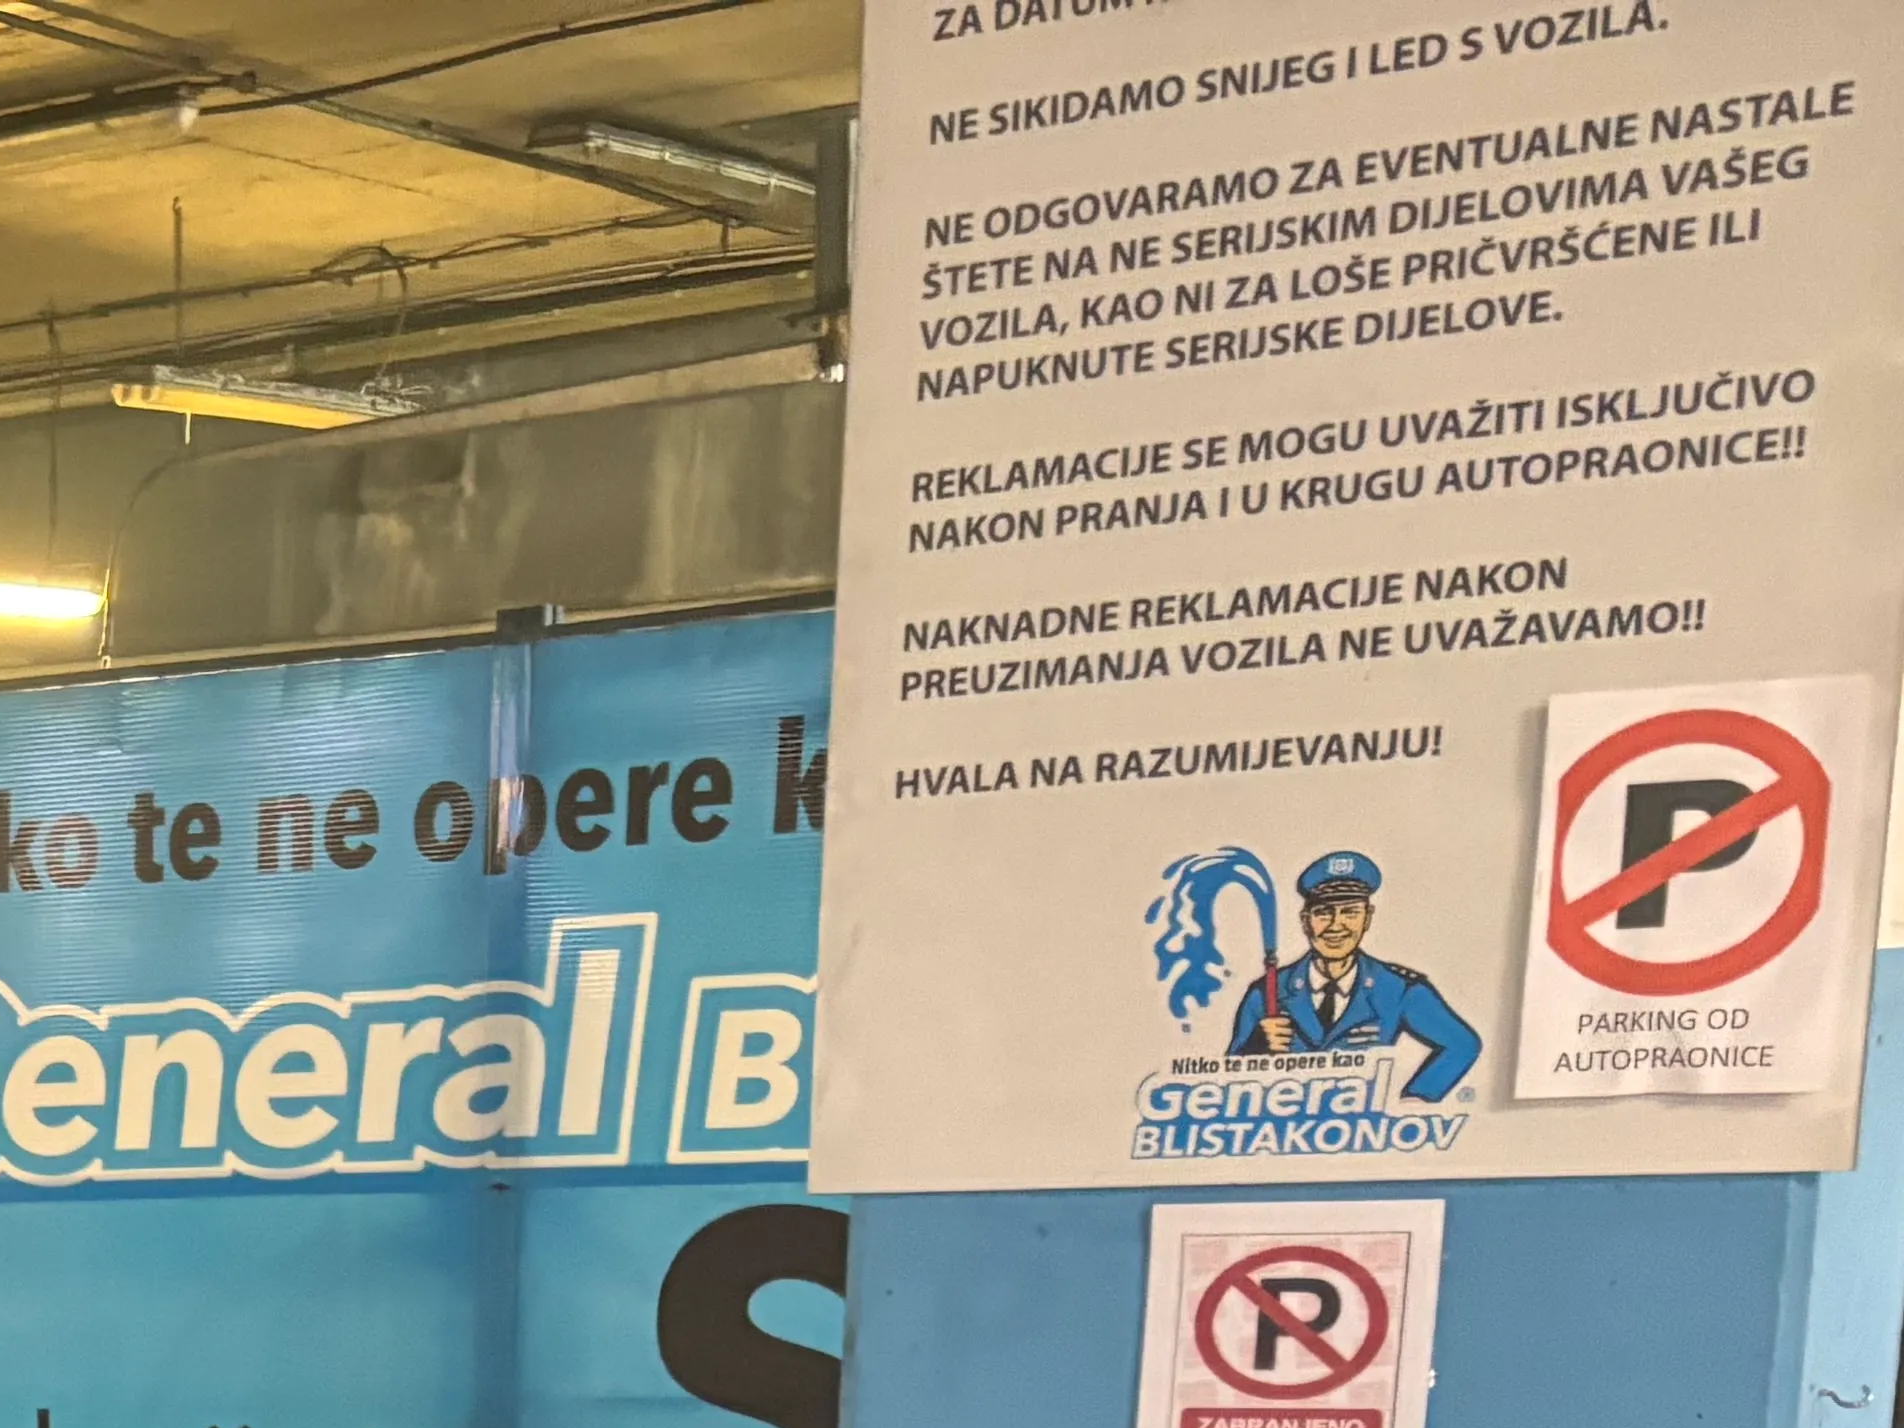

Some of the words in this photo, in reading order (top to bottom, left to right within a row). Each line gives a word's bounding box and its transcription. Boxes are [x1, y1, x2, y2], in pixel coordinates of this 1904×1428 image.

[929, 107, 979, 146] NE
[988, 75, 1185, 136] SIKIDAMO
[1196, 50, 1335, 103] SNIJEG
[1346, 46, 1357, 80] I
[1368, 33, 1448, 76] LED
[1459, 26, 1484, 62] S
[1494, 0, 1669, 55] VOZILA.
[933, 5, 984, 41] ZA
[924, 212, 974, 249] NE
[983, 166, 1280, 239] ODGOVARAMO
[1288, 157, 1343, 195] ZA
[1355, 112, 1638, 186] EVENTUALNE
[1650, 80, 1856, 144] NASTALE
[921, 254, 1033, 300] ŠTETE
[1043, 245, 1099, 283] NA
[1110, 235, 1161, 273] NE
[1171, 205, 1376, 265] SERIJSKIM
[1388, 168, 1649, 235] DIJELOVIMA
[1661, 144, 1809, 196] VAŠEG
[919, 303, 1069, 351] VOZILA,
[1080, 288, 1164, 329] KAO
[1174, 280, 1214, 316] NI
[1224, 272, 1279, 310] ZA
[1290, 254, 1391, 301] LOŠE
[1402, 216, 1697, 287] PRIČVRŠĆENE
[1708, 207, 1761, 247] ILI
[916, 340, 1155, 402] NAPUKNUTE
[1165, 316, 1344, 369] SERIJSKE
[1354, 290, 1563, 346] DIJELOVE.
[911, 441, 1172, 503] REKLAMACIJE
[1181, 435, 1228, 471] SE
[1238, 418, 1368, 464] MOGU
[1379, 398, 1545, 448] UVAŽITI
[1556, 368, 1816, 429] ISKLJUČIVO
[908, 508, 1044, 554] NAKON
[1055, 489, 1208, 536] PRANJA
[1219, 486, 1230, 518] I
[1241, 481, 1269, 515] U
[1279, 465, 1425, 512] KRUGU
[1434, 425, 1807, 495] AUTOPRAONICE!!
[900, 647, 1170, 702] PREUZIMANJA
[1180, 632, 1327, 675] VOZILA
[1338, 625, 1393, 661] NE
[1404, 598, 1706, 655] UVAŽAVAMO!!
[902, 601, 1120, 653] NAKNADNE
[1130, 572, 1404, 629] REKLAMACIJE
[1414, 556, 1568, 602] NAKON
[895, 760, 1019, 800] HVALA
[1030, 755, 1084, 788] NA
[1095, 724, 1443, 783] RAZUMIJEVANJU!
[129, 789, 222, 884] te
[255, 784, 379, 873] ne
[412, 754, 733, 876] opere
[1172, 1056, 1219, 1076] Nitko
[1223, 1057, 1242, 1073] te
[1246, 1057, 1270, 1072] ne
[1274, 1055, 1327, 1073] opere
[1331, 1051, 1366, 1069] kao
[1553, 1044, 1775, 1073] AUTOPRAONICE
[1578, 1009, 1698, 1035] PARKING
[1707, 1006, 1750, 1031] OD
[1131, 1114, 1469, 1160] BLISTAKONOV
[1137, 1058, 1393, 1121] General
